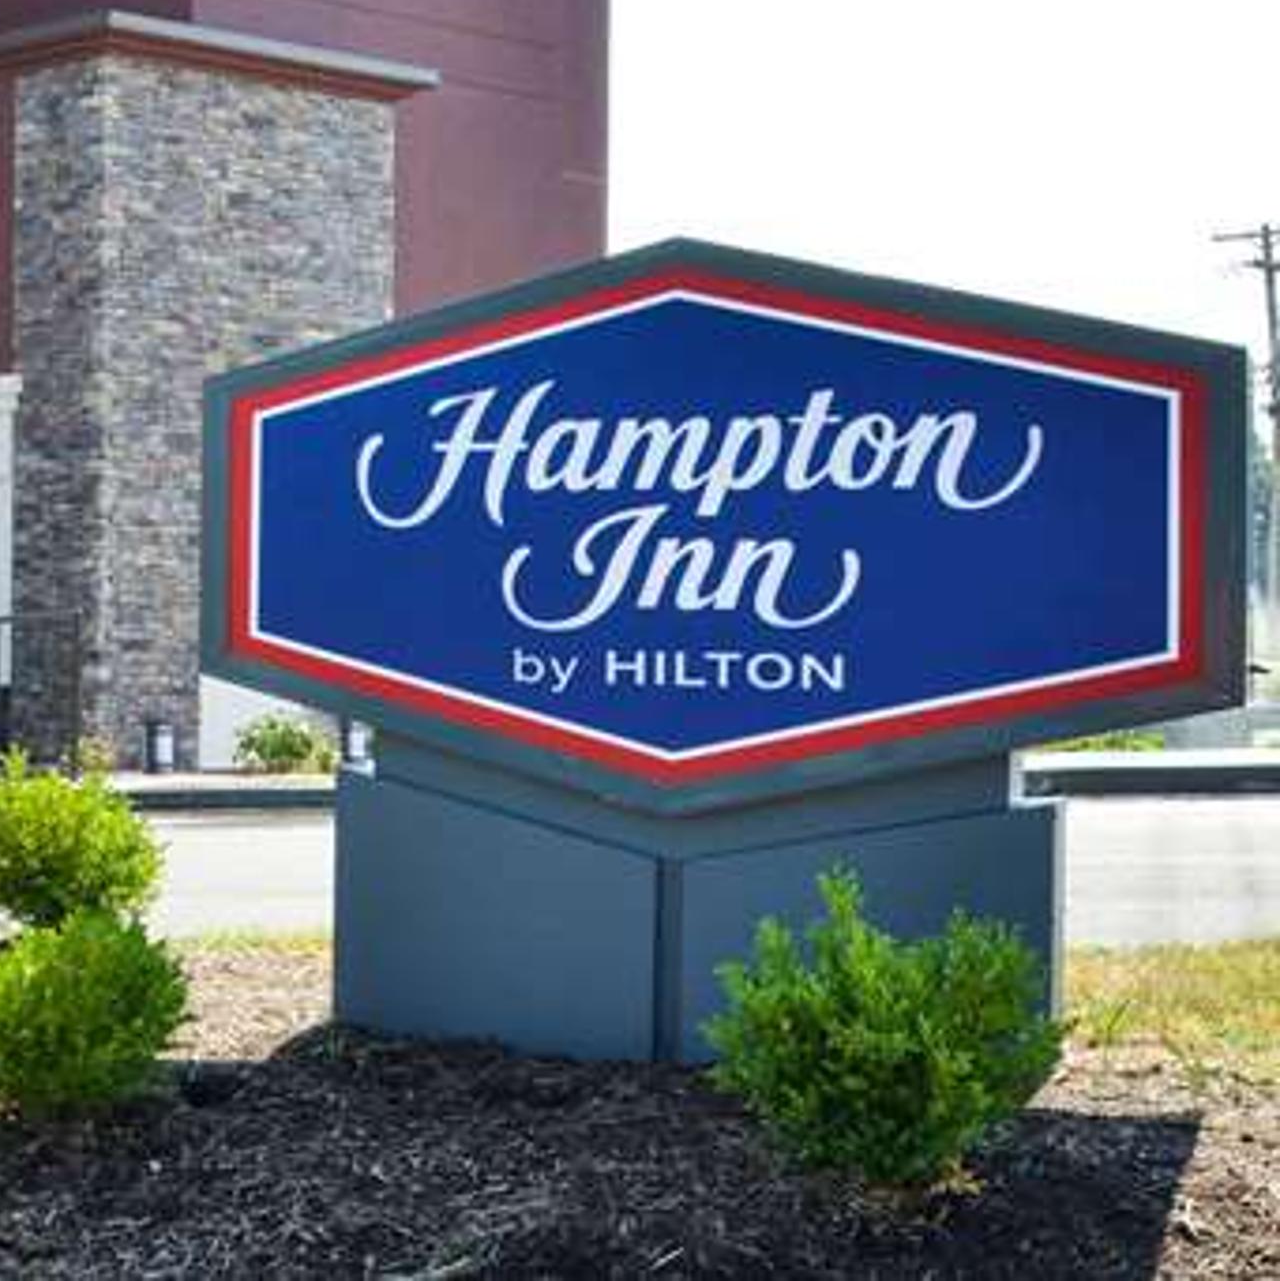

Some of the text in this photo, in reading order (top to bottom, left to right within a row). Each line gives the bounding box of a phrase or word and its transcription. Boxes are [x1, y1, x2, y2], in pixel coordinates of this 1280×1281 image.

[356, 379, 1042, 528] Hampton
[502, 504, 861, 631] Inn
[513, 649, 846, 693] by HILTON
